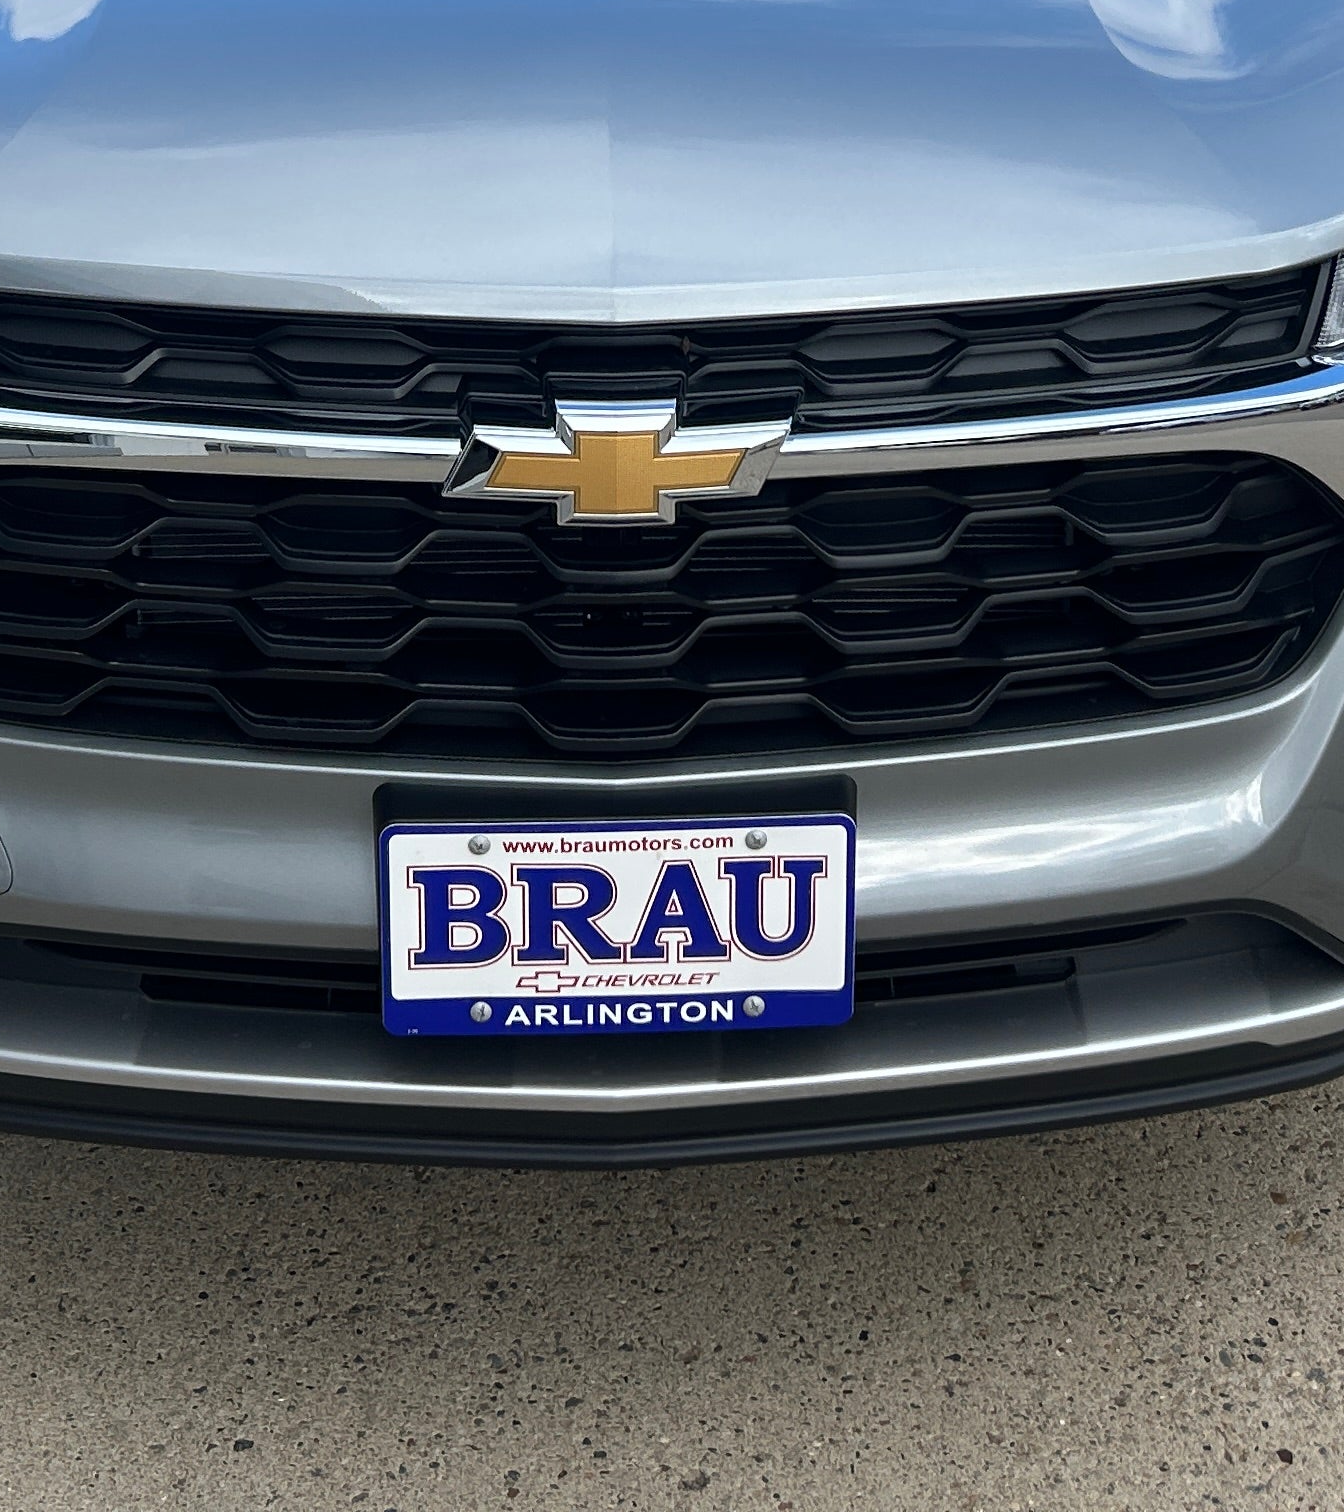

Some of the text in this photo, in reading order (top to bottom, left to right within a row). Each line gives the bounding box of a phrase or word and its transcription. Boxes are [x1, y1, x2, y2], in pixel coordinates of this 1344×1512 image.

[501, 832, 735, 856] www.braumotors.com
[406, 855, 828, 971] BRAU
[580, 971, 720, 988] CHEVROLET
[504, 998, 735, 1026] ARLINGTON
